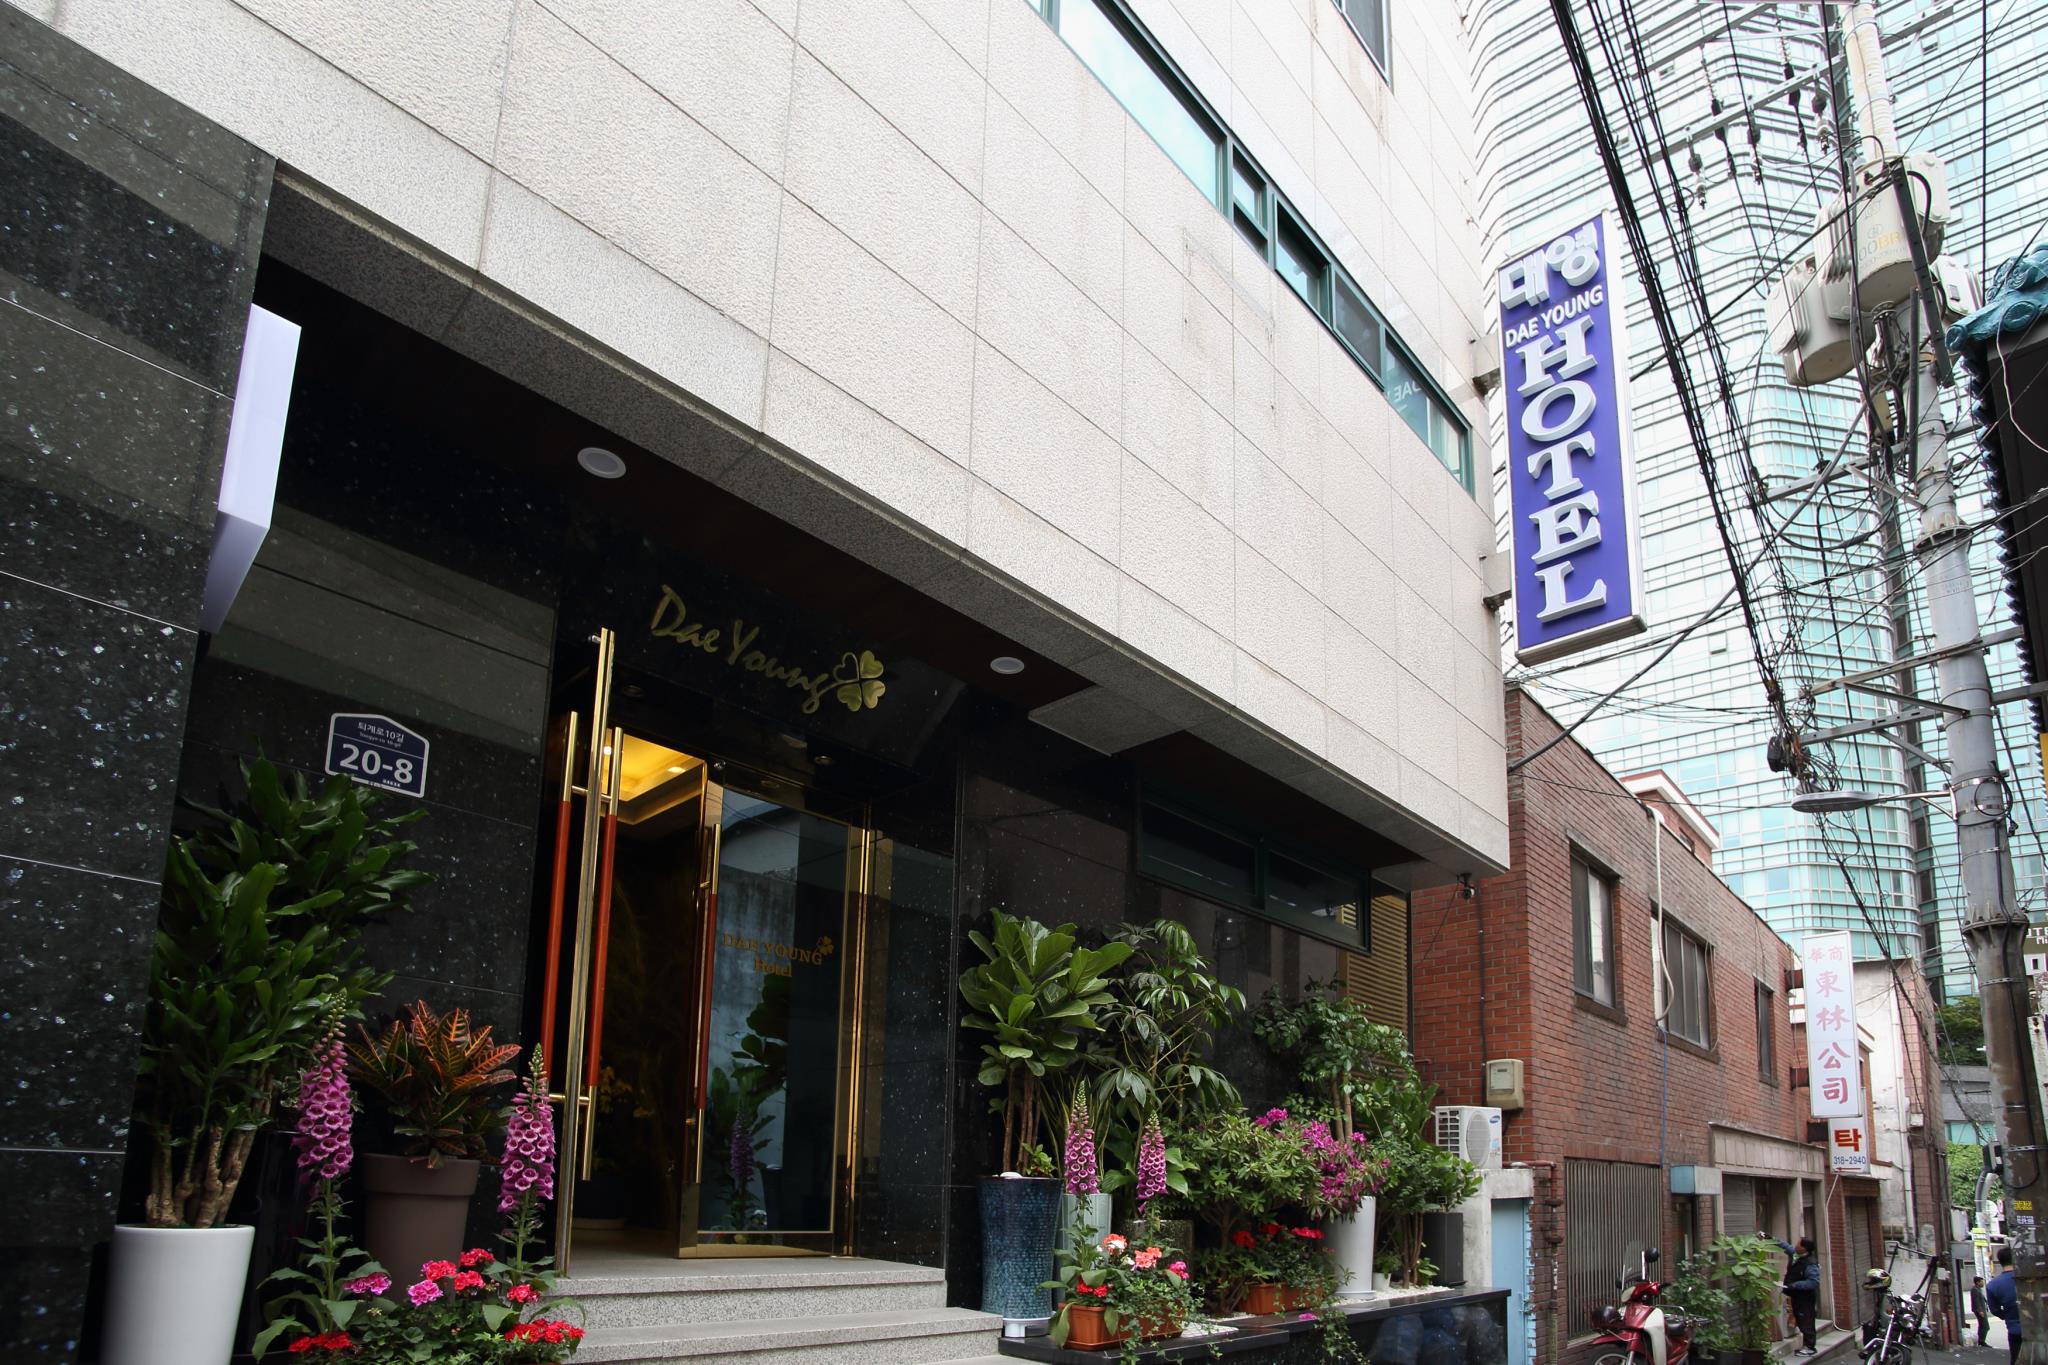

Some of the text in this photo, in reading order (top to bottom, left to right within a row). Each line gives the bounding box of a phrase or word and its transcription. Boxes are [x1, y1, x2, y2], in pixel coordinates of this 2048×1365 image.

[1500, 222, 1600, 310] 대영
[1504, 284, 1604, 349] DAE YOUNG
[1515, 314, 1608, 623] HOTEL
[651, 584, 829, 714] Dae Young
[340, 743, 413, 784] 20-8
[755, 957, 793, 977] Hotel
[764, 941, 822, 966] YOUNG
[1815, 970, 1851, 1104] 東林公司
[1833, 1155, 1867, 1166] 318-2940
